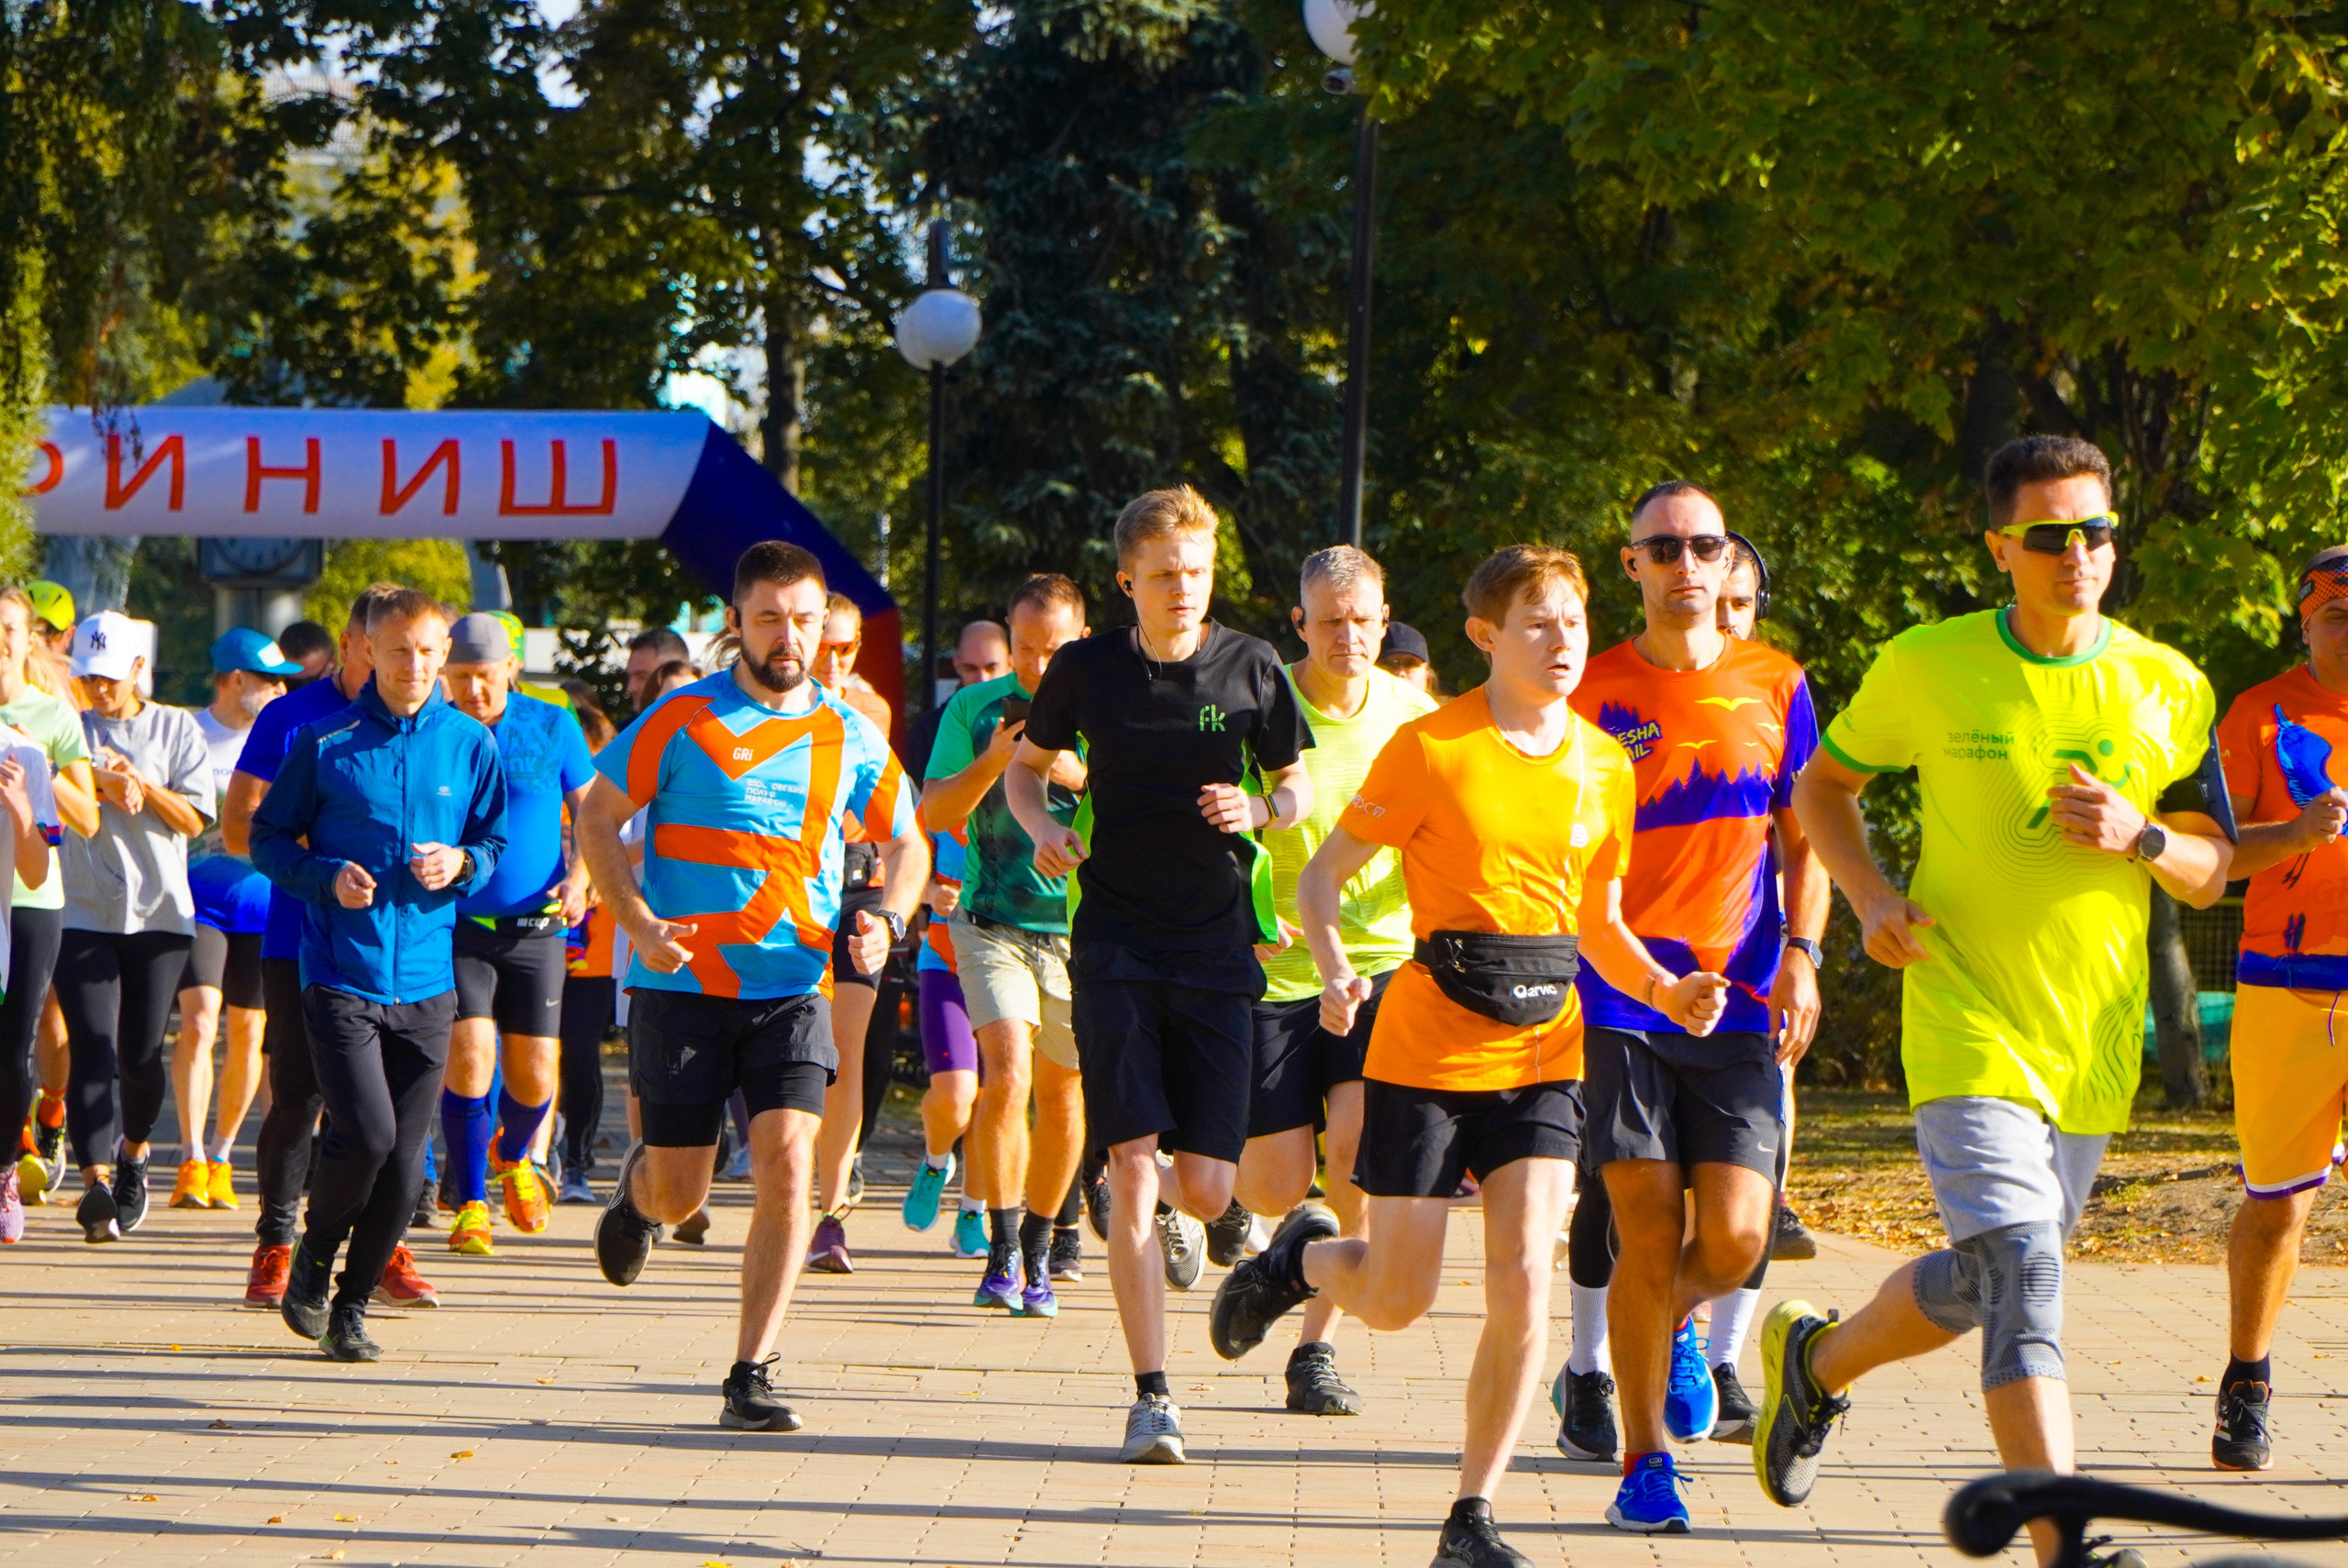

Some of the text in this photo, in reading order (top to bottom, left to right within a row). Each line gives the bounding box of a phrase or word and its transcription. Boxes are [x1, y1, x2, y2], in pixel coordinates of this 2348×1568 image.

[1617, 722, 1660, 747] ESHA
[1946, 728, 2015, 745] зелёный
[1624, 743, 1652, 761] AIL
[1943, 744, 2009, 762] марафон
[747, 778, 807, 795] МОСОВСКИЙ
